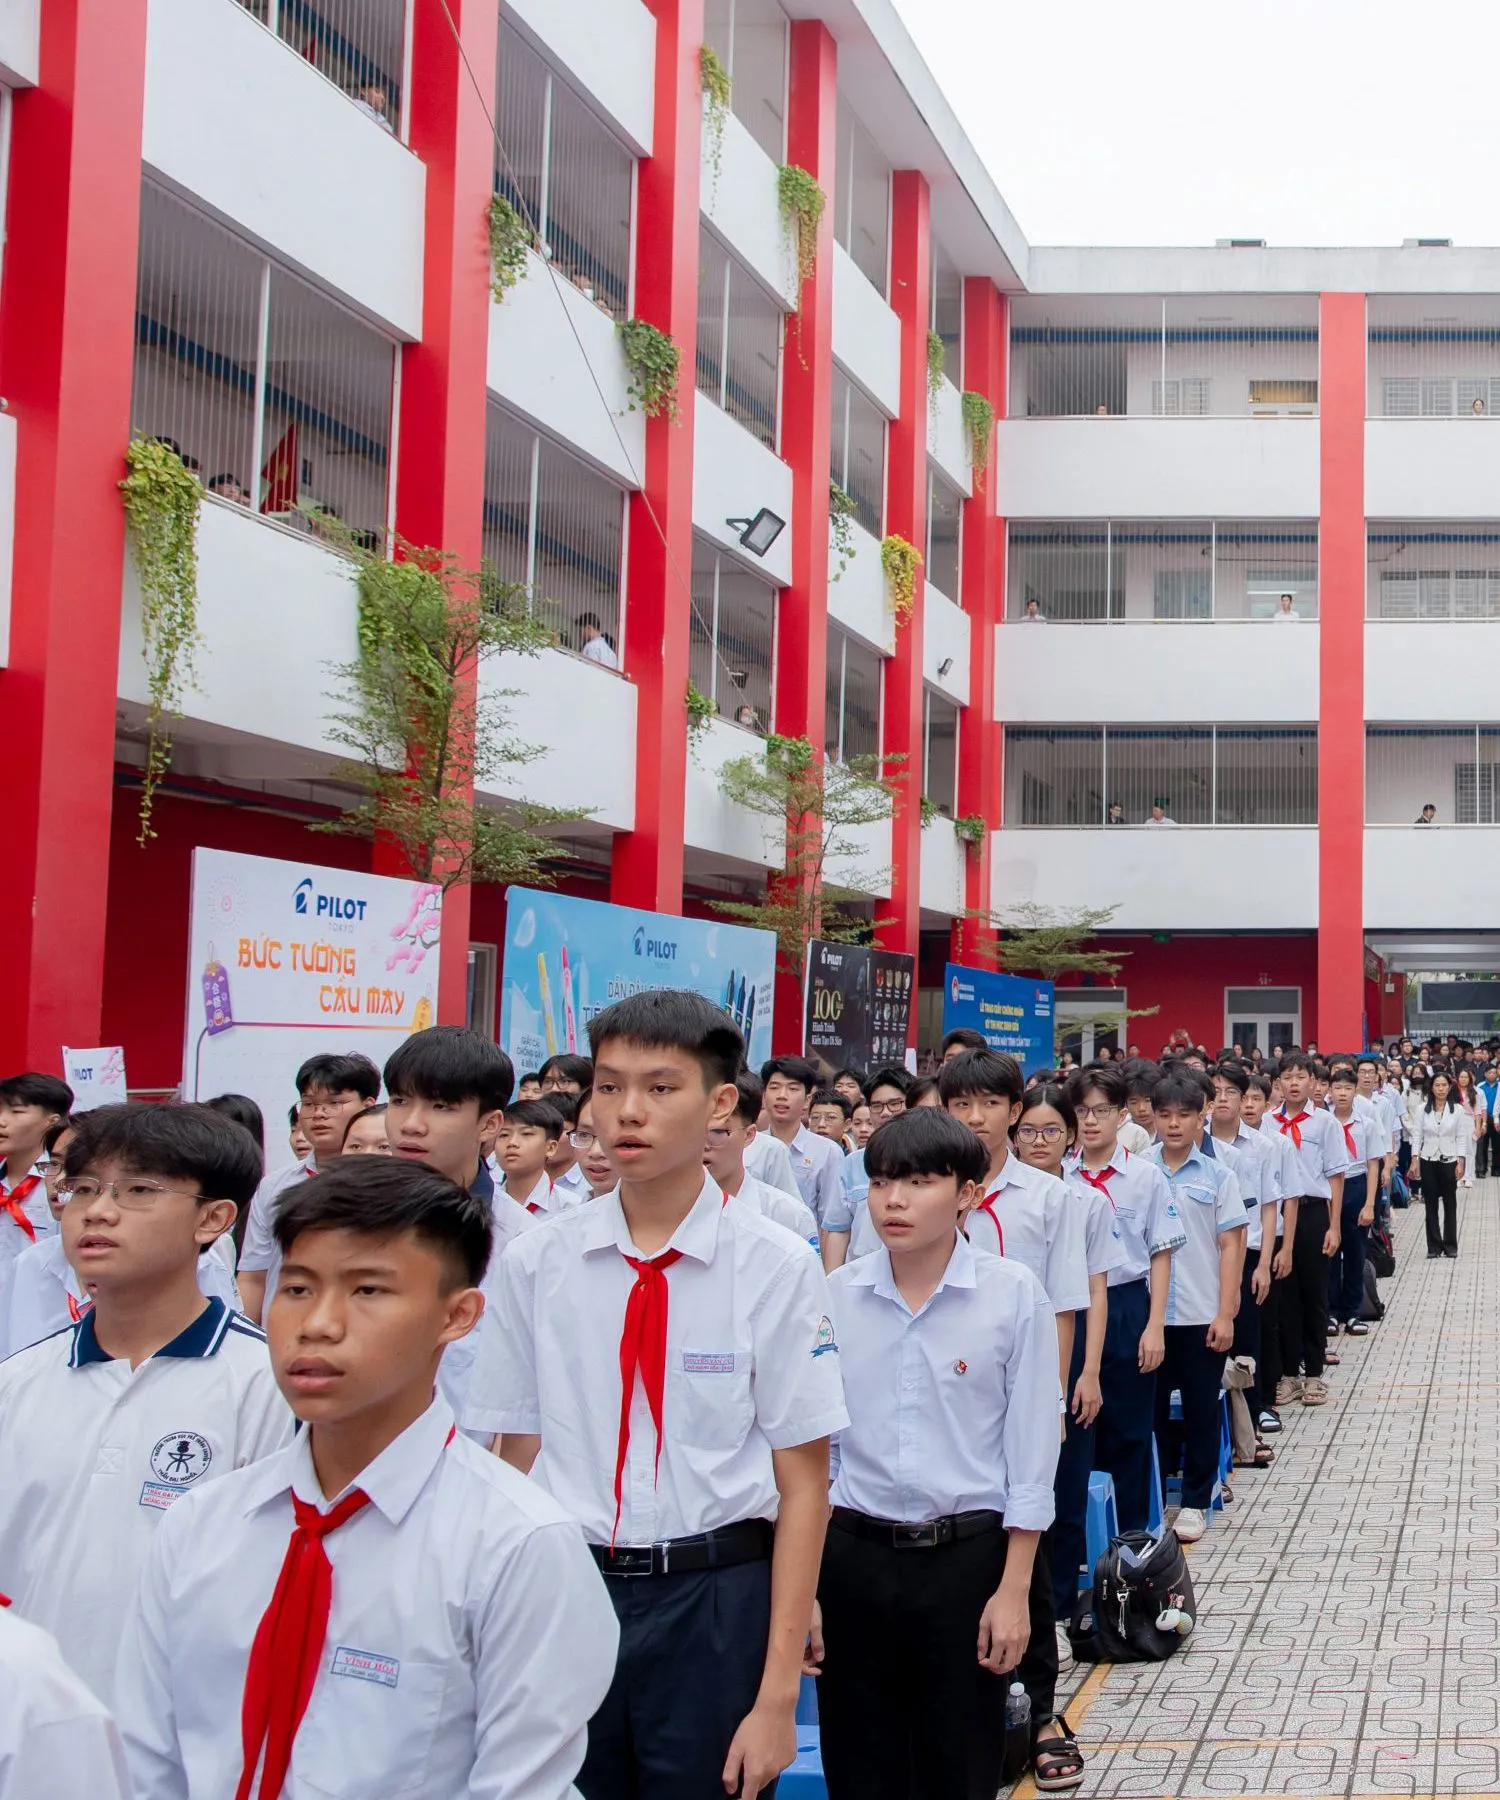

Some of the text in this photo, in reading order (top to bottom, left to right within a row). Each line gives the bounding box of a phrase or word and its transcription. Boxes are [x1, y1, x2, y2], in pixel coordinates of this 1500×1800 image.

[316, 895, 367, 921] PILOT
[237, 932, 357, 977] BỨC TƯỜNG
[647, 939, 678, 960] PILOT
[827, 954, 843, 966] PILOT
[319, 976, 405, 1016] CẦU MAY
[812, 989, 841, 1020] 100
